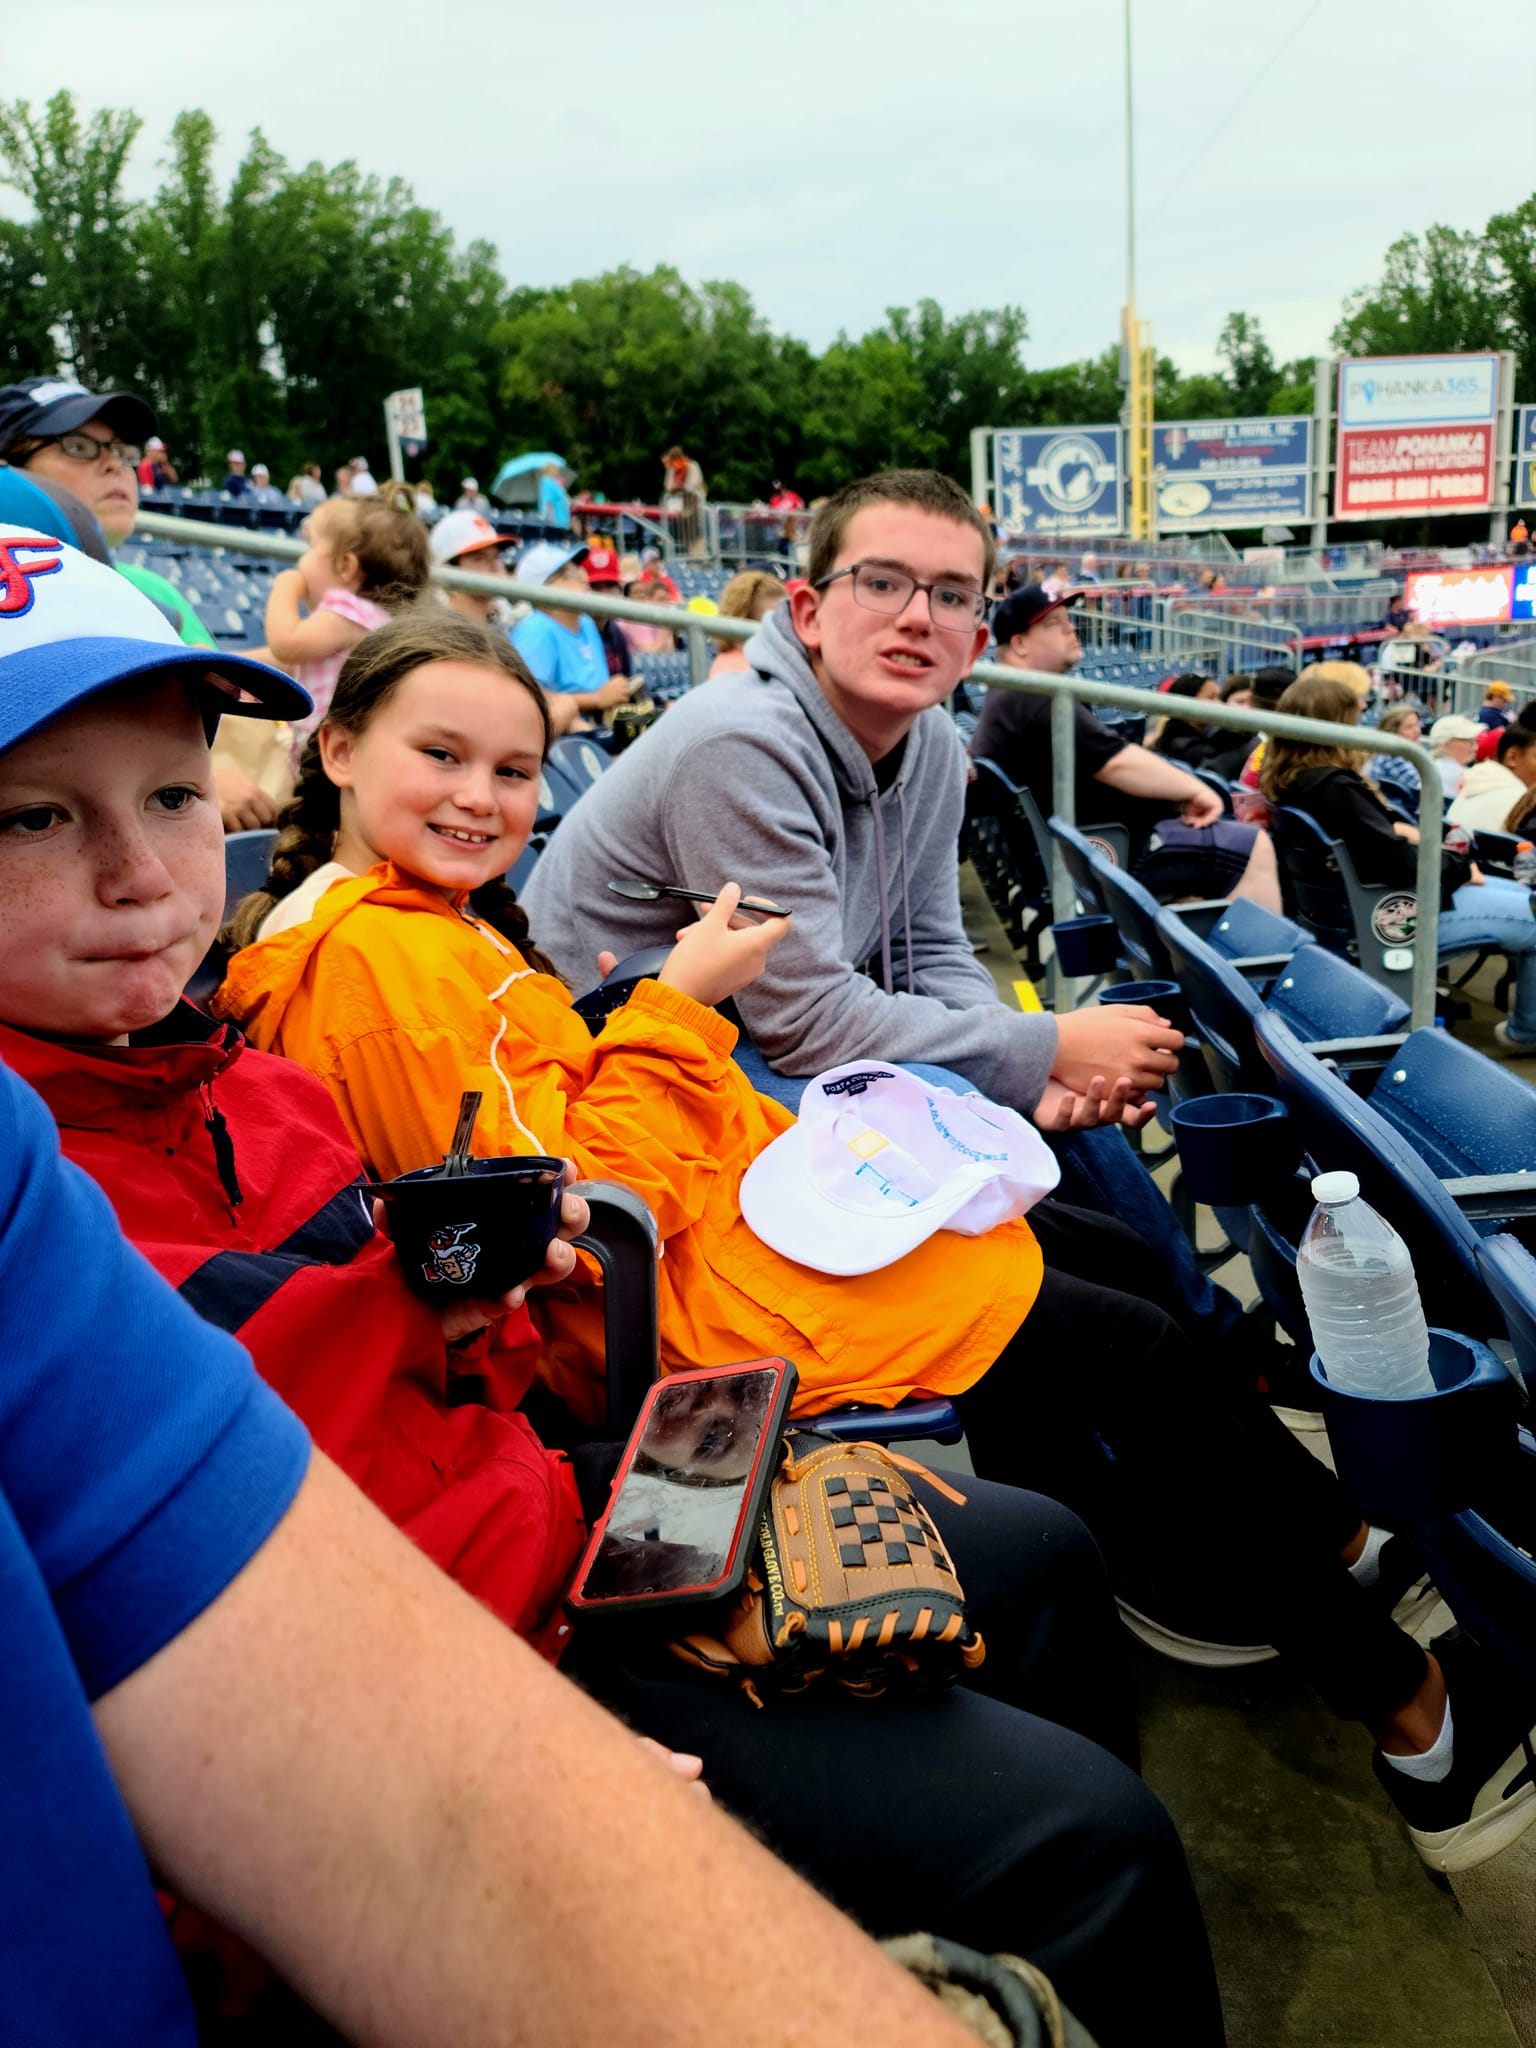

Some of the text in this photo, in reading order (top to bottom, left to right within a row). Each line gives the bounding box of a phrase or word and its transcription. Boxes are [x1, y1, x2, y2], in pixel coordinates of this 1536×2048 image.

[1347, 433, 1486, 461] TEAM POHANKA
[1348, 457, 1412, 475] NISSAN
[825, 1080, 845, 1093] PORT
[763, 1548, 782, 1583] GLOVE
